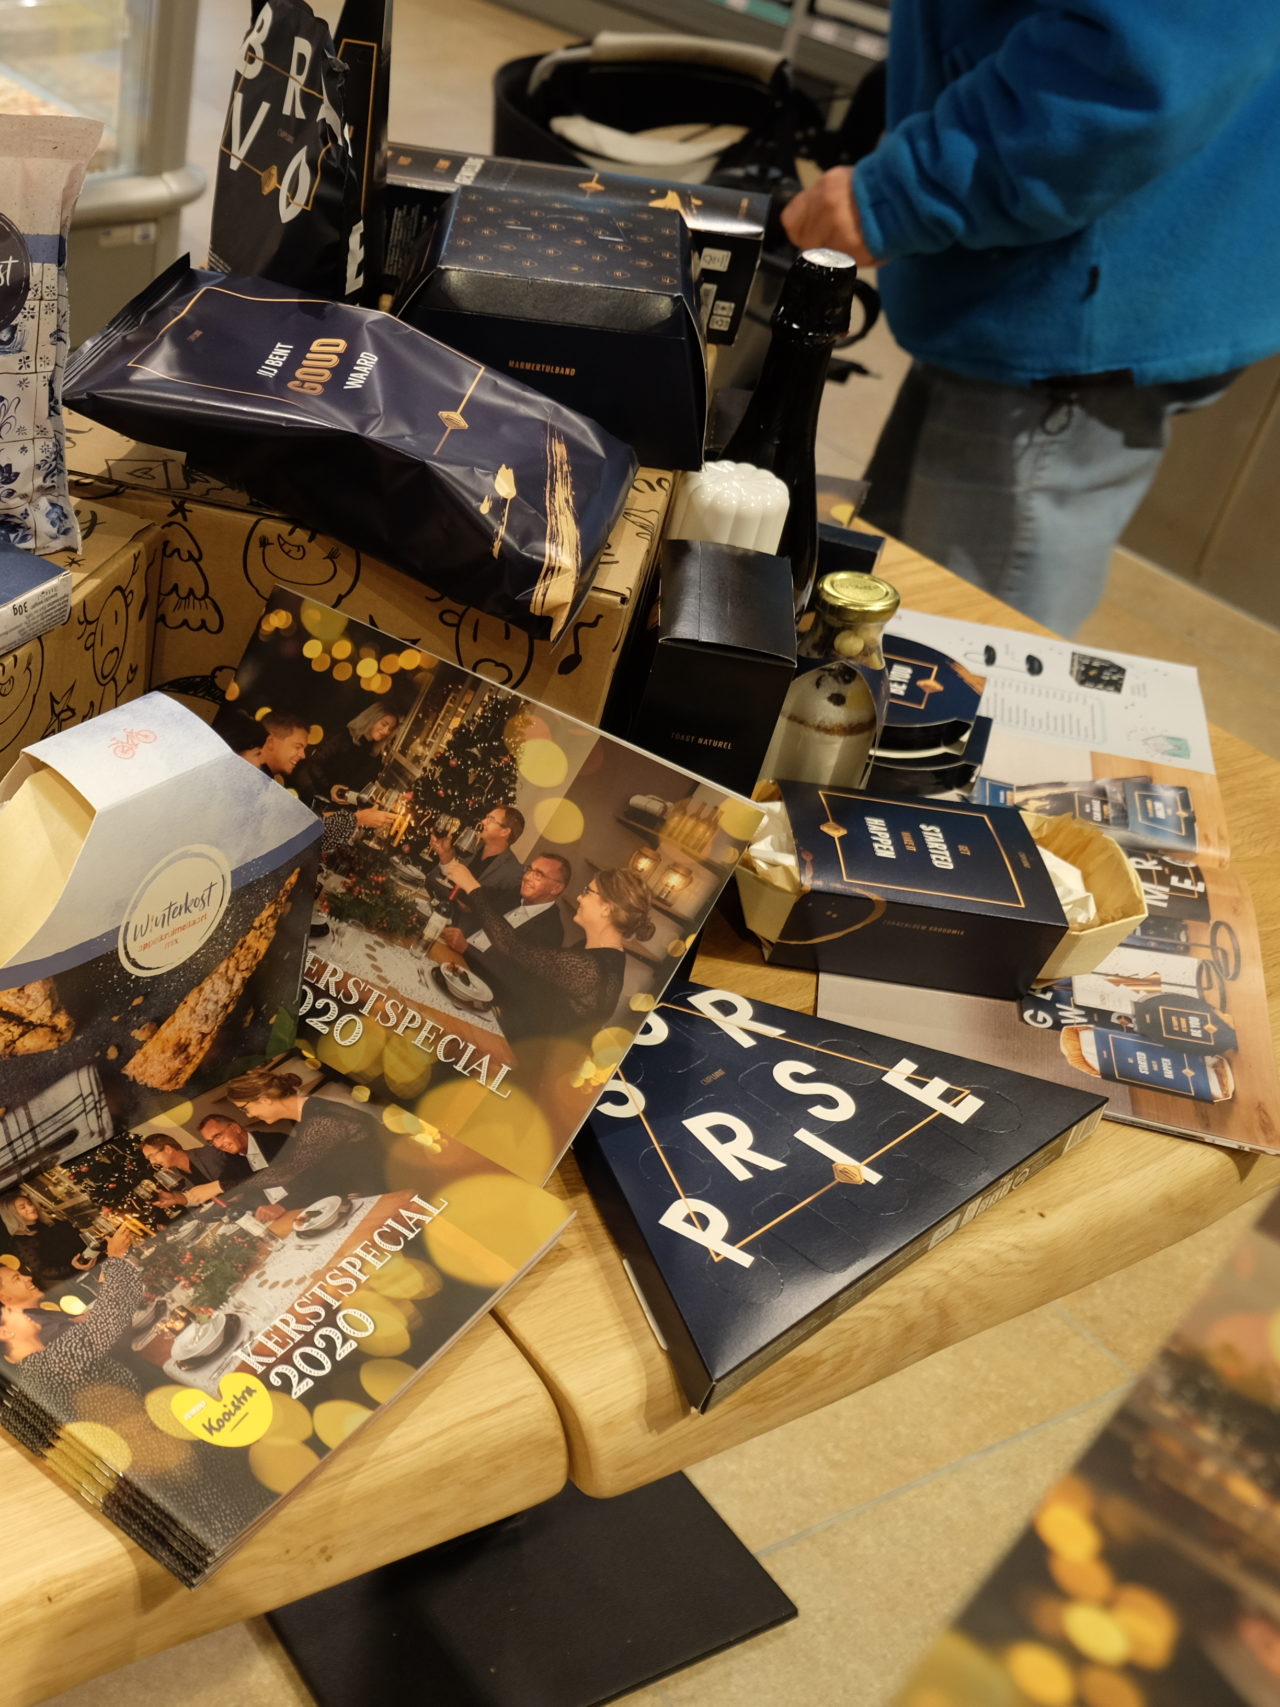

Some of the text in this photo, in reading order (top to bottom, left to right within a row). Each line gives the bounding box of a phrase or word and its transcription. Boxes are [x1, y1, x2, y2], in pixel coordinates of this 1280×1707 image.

[264, 342, 294, 368] BENT
[287, 338, 348, 396] GOUD
[343, 351, 379, 390] WAARD
[12, 602, 29, 616] 30g
[698, 737, 733, 751] NATUREL
[864, 816, 897, 859] HAPPEN
[919, 823, 955, 871] STARTED
[133, 881, 218, 942] Winterkost
[303, 950, 513, 1099] ERSTSPECIAL
[232, 1194, 449, 1375] KERSTSPECIAL
[269, 1308, 376, 1400] 2020
[201, 1384, 258, 1436] Kooistra
